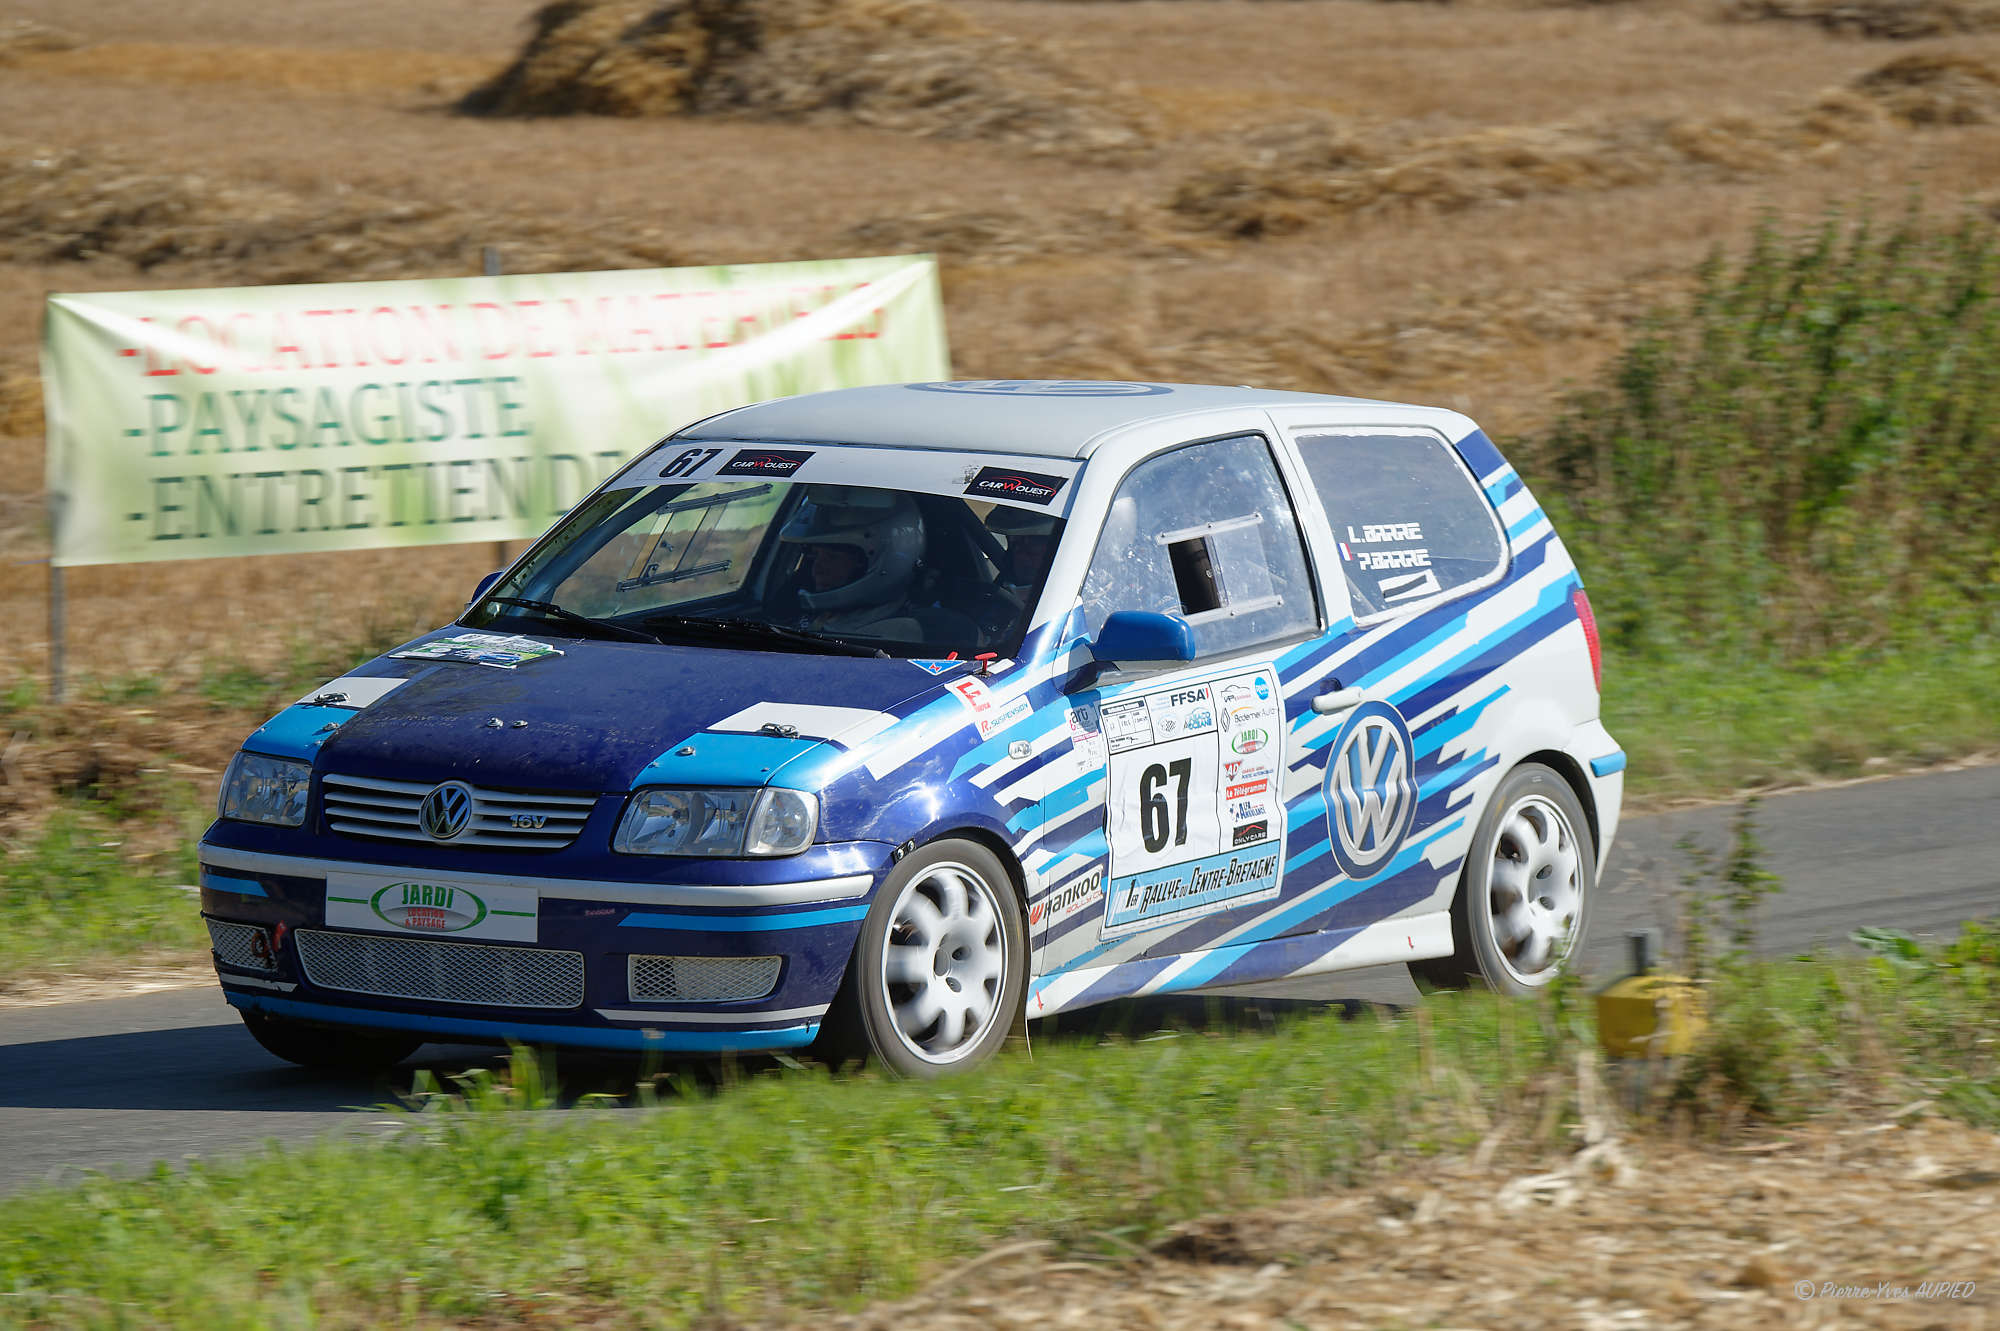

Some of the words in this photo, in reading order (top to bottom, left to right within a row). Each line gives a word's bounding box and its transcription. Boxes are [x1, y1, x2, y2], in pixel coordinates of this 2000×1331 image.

[658, 448, 724, 477] 67
[1170, 688, 1206, 706] FFSA
[1139, 757, 1192, 853] 67
[510, 814, 549, 829] 16V
[402, 884, 454, 908] JARDI
[1139, 878, 1182, 914] RALLYE
[1188, 855, 1277, 894] CENTRE-BRETAGNE
[412, 917, 446, 929] PAYSAGE
